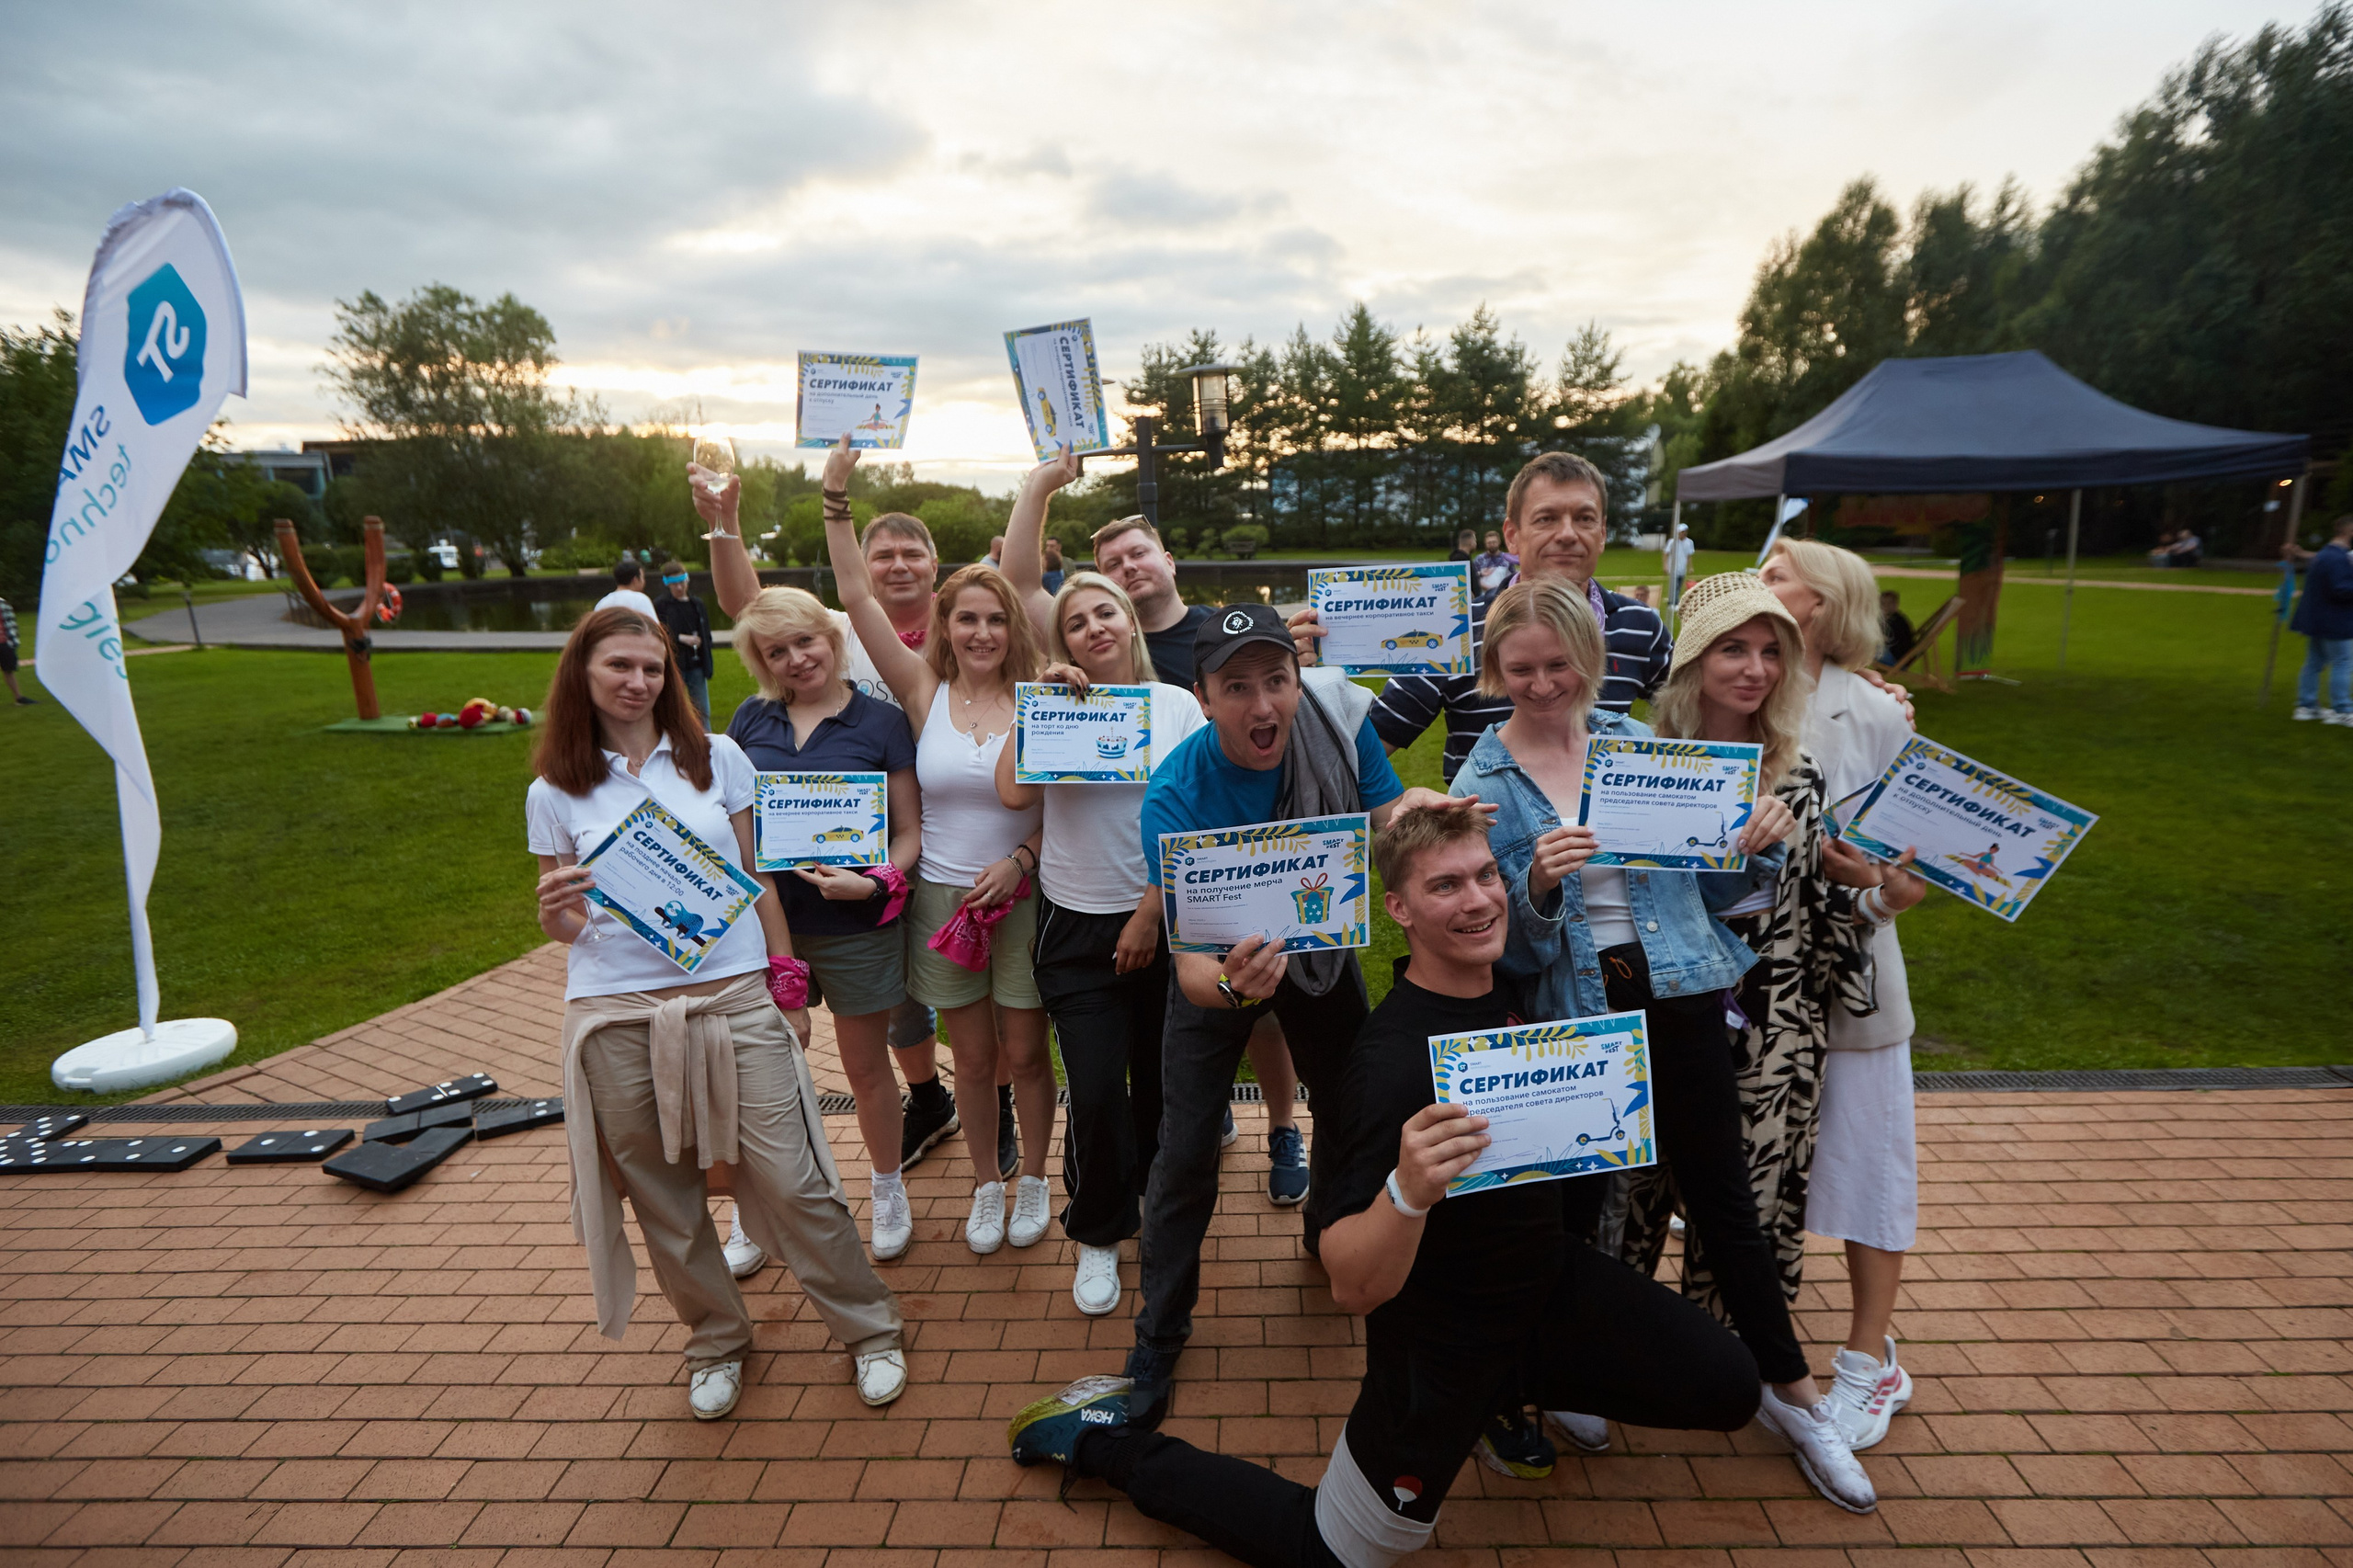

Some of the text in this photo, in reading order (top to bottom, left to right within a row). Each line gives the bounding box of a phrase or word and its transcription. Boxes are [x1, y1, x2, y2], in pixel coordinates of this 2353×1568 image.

[810, 379, 892, 391] СЕРТИФИКАТ
[1060, 336, 1084, 428] СЕРТИФИКАТ
[1324, 597, 1437, 612] СЕРТИФИКАТ
[1031, 711, 1127, 722] СЕРТИФИКАТ
[1601, 773, 1725, 792] СЕРТИФИКАТ
[768, 798, 861, 809] СЕРТИФИКАТ
[1600, 798, 1650, 807] председателя
[1900, 797, 1933, 815] отпуску
[1904, 774, 2037, 838] СЕРТИФИКАТ
[1909, 791, 1982, 829] дополнительный
[1981, 826, 2003, 838] день
[619, 846, 650, 871] рабочего
[649, 869, 660, 880] дня
[667, 881, 684, 897] 12:00
[633, 831, 724, 901] СЕРТИФИКАТ
[635, 846, 661, 867] позднее
[660, 866, 682, 885] начало
[1184, 854, 1328, 884] СЕРТИФИКАТ
[1200, 883, 1252, 895] получение
[1254, 878, 1283, 888] мерча
[1187, 895, 1220, 903] SMART
[1459, 1060, 1608, 1095] СЕРТИФИКАТ
[1475, 1092, 1530, 1106] пользование
[1532, 1085, 1577, 1097] самокатом
[1526, 1098, 1553, 1108] совета
[1555, 1090, 1604, 1104] директоров
[1081, 1408, 1115, 1424] HOKA
